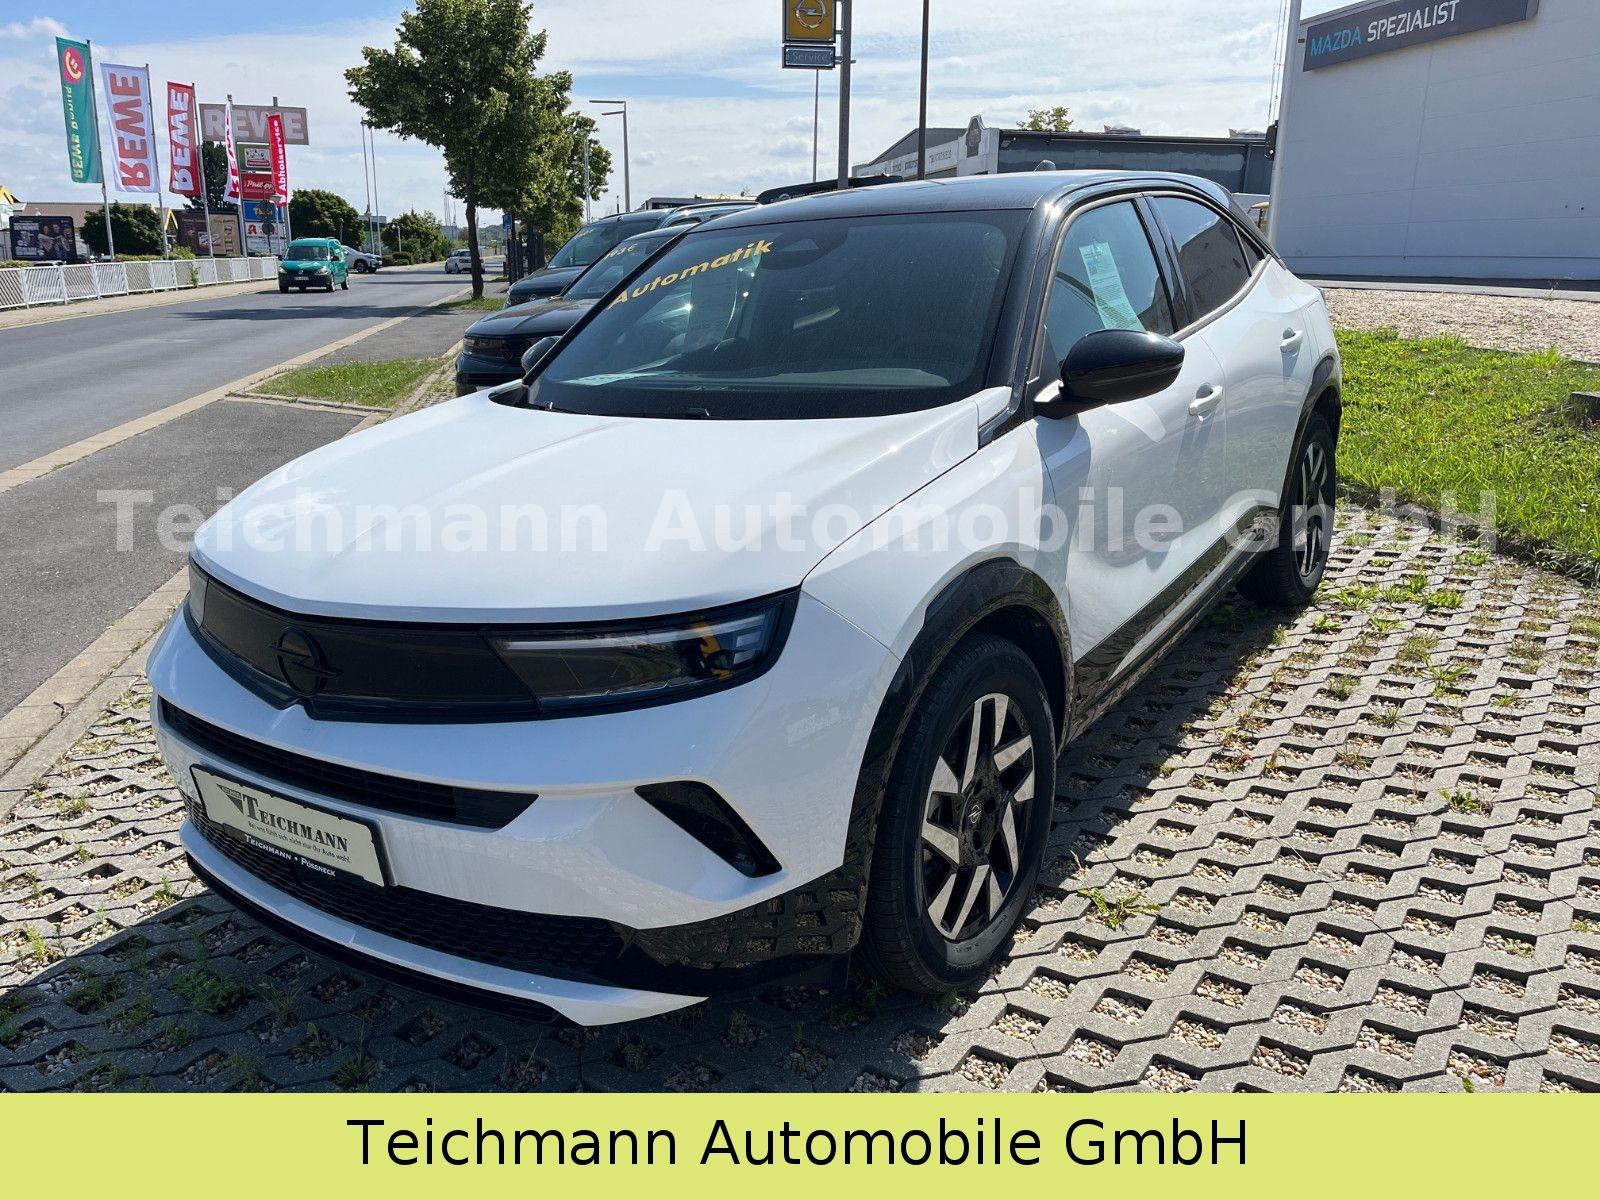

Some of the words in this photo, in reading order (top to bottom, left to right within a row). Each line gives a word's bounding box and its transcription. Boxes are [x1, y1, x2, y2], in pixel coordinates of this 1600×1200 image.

[792, 50, 828, 62] Service
[1310, 26, 1362, 56] MAZDA
[1367, 0, 1460, 42] SPEZIALIST
[203, 109, 305, 140] REWE
[273, 119, 287, 192] Abholservice
[607, 240, 774, 310] Automatik
